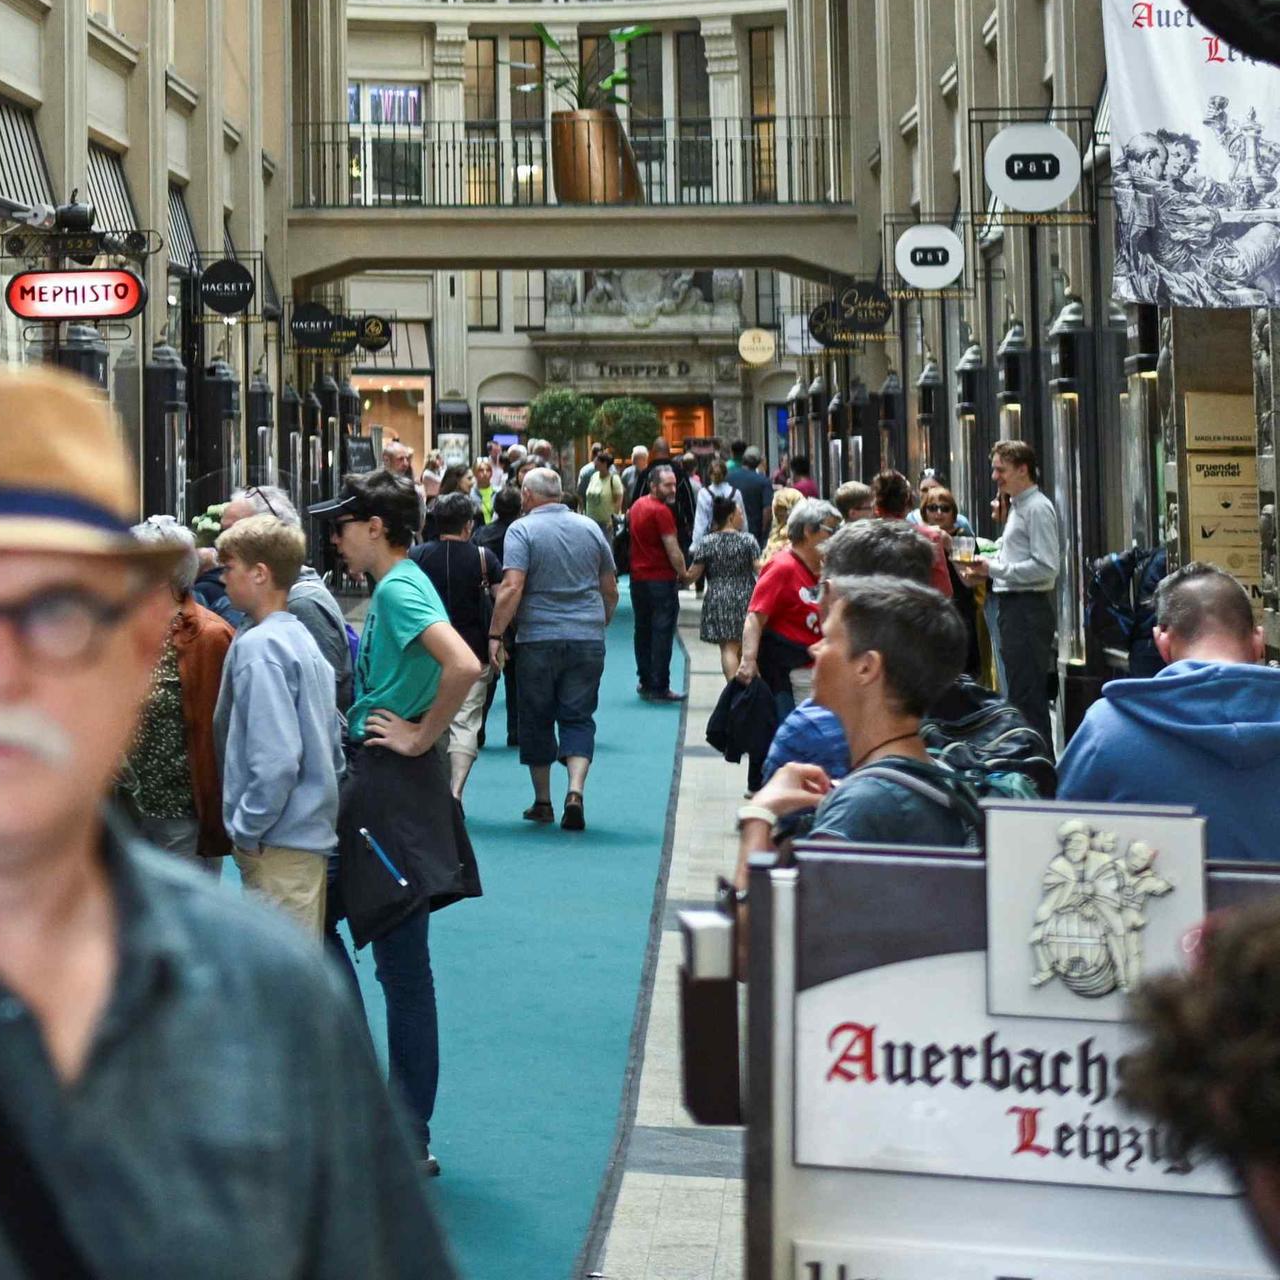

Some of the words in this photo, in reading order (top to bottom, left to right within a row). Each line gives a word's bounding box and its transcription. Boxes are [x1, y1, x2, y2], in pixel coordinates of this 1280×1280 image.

[201, 282, 252, 292] HACKETT
[19, 282, 130, 306] MEPHISTO
[292, 320, 333, 329] HACKETT
[1195, 462, 1240, 472] gruendel
[1203, 469, 1242, 478] partner
